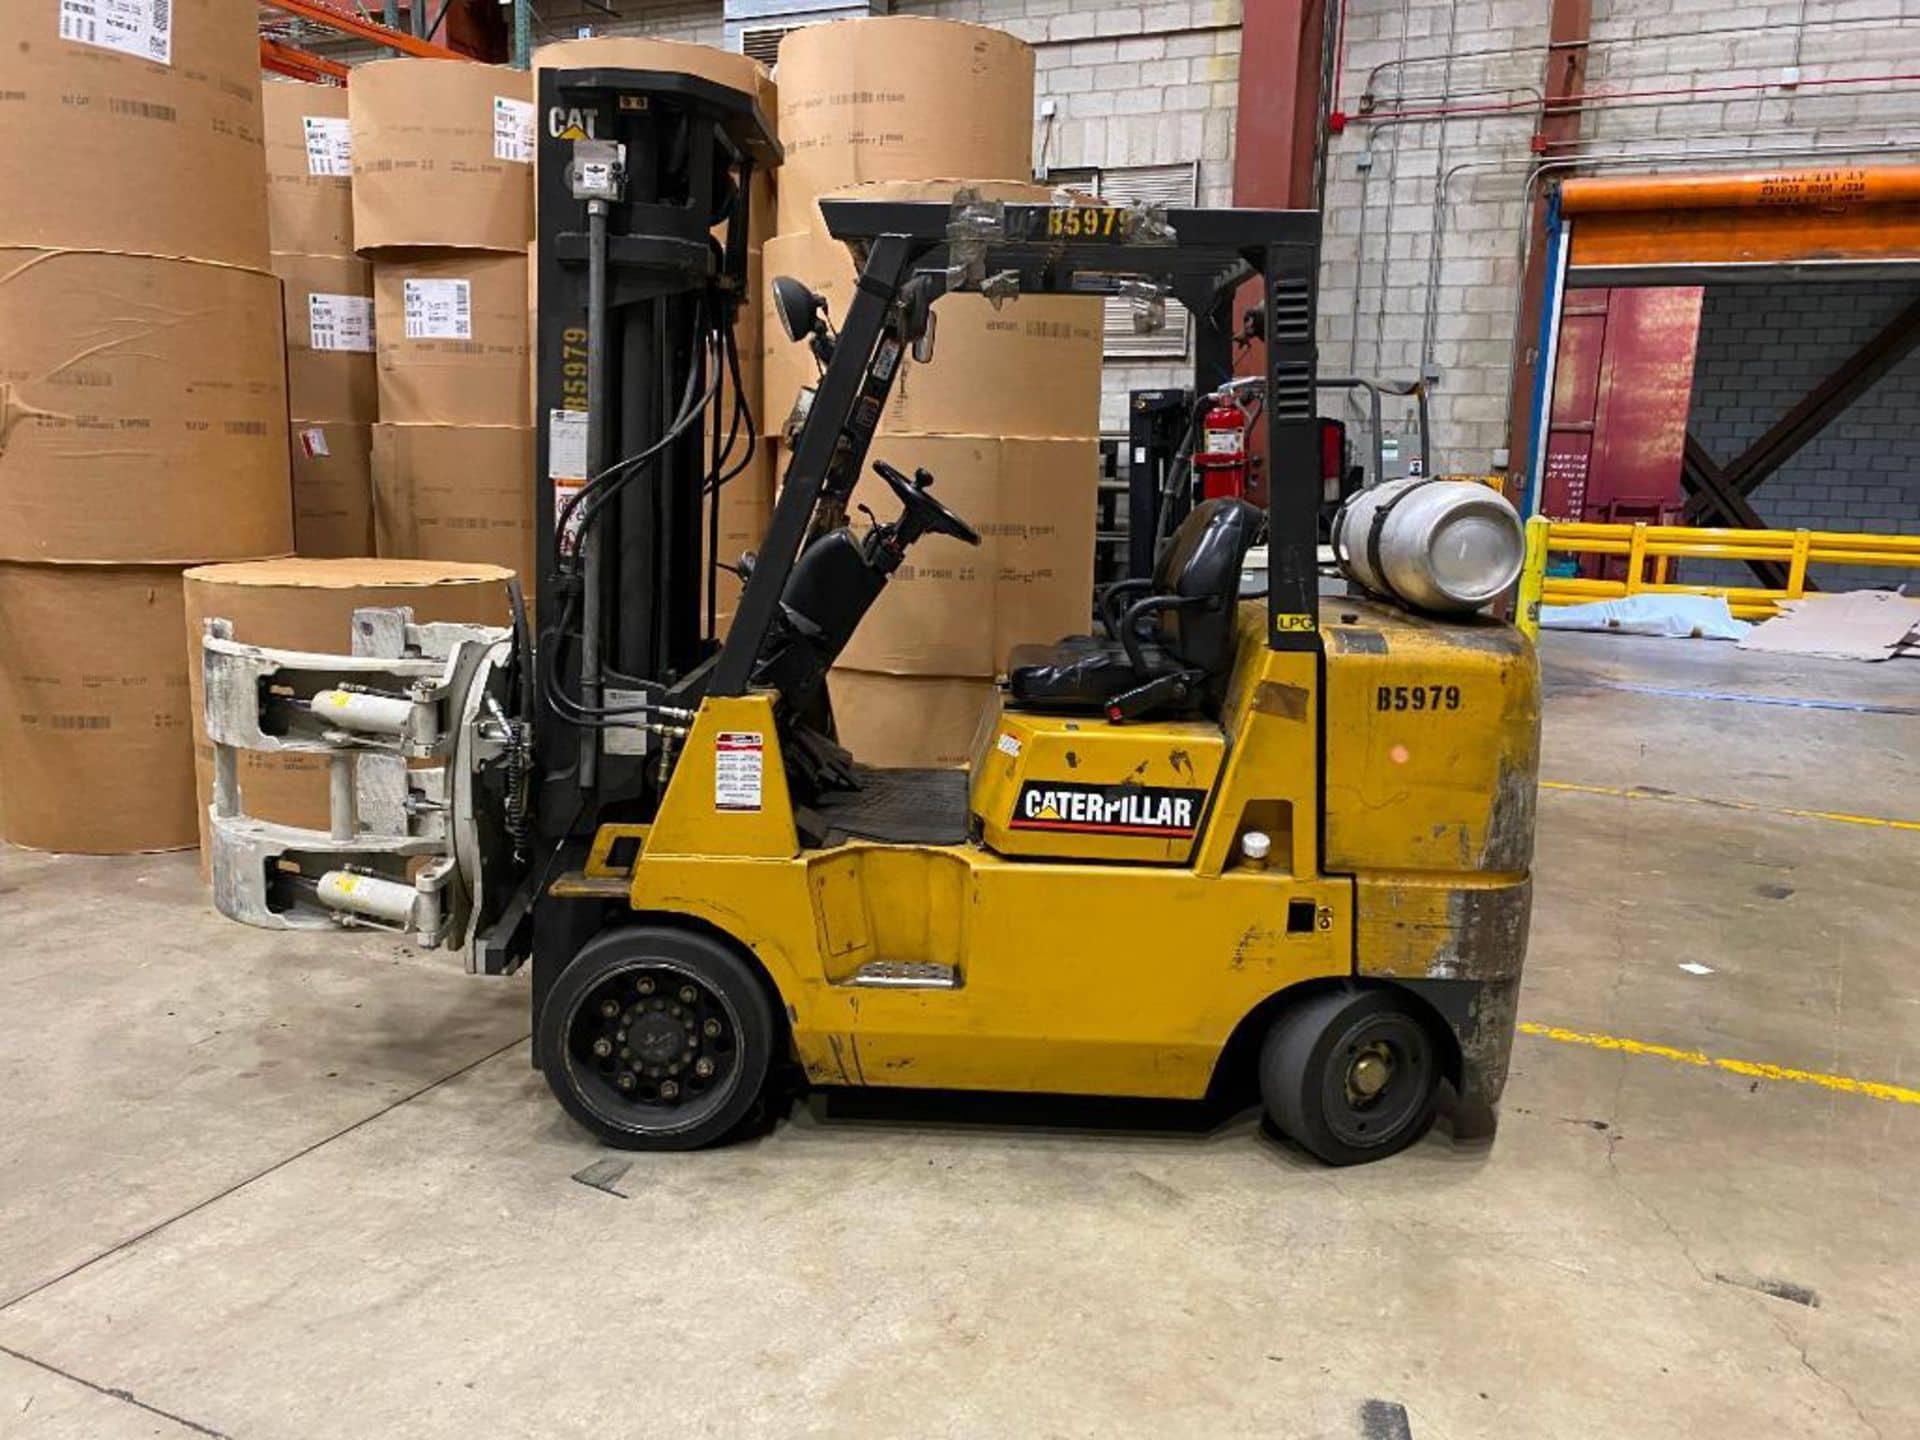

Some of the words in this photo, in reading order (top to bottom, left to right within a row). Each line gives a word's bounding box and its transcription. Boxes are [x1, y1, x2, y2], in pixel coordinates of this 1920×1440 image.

[549, 107, 598, 140] CAT
[563, 328, 588, 412] B5979
[1377, 686, 1460, 711] B5979
